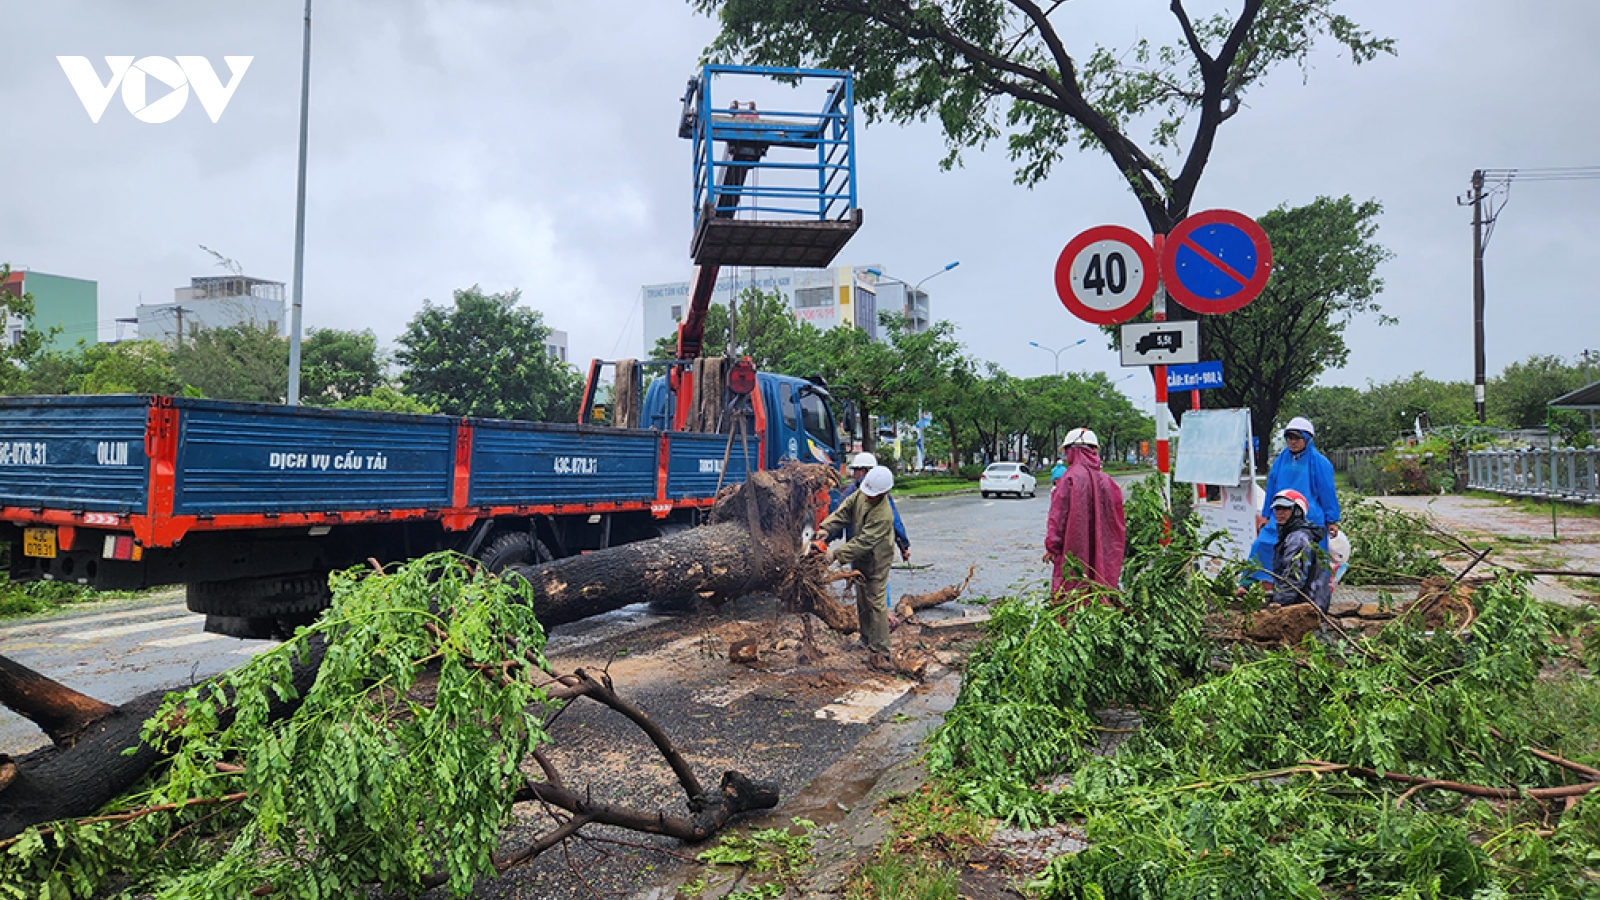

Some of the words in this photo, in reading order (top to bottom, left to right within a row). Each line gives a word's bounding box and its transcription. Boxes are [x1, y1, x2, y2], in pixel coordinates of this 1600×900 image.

[1083, 251, 1127, 296] 40
[97, 441, 128, 465] OLLIN
[269, 452, 308, 470] DỊCH
[311, 454, 330, 471] VỤ
[366, 452, 388, 470] TẢI
